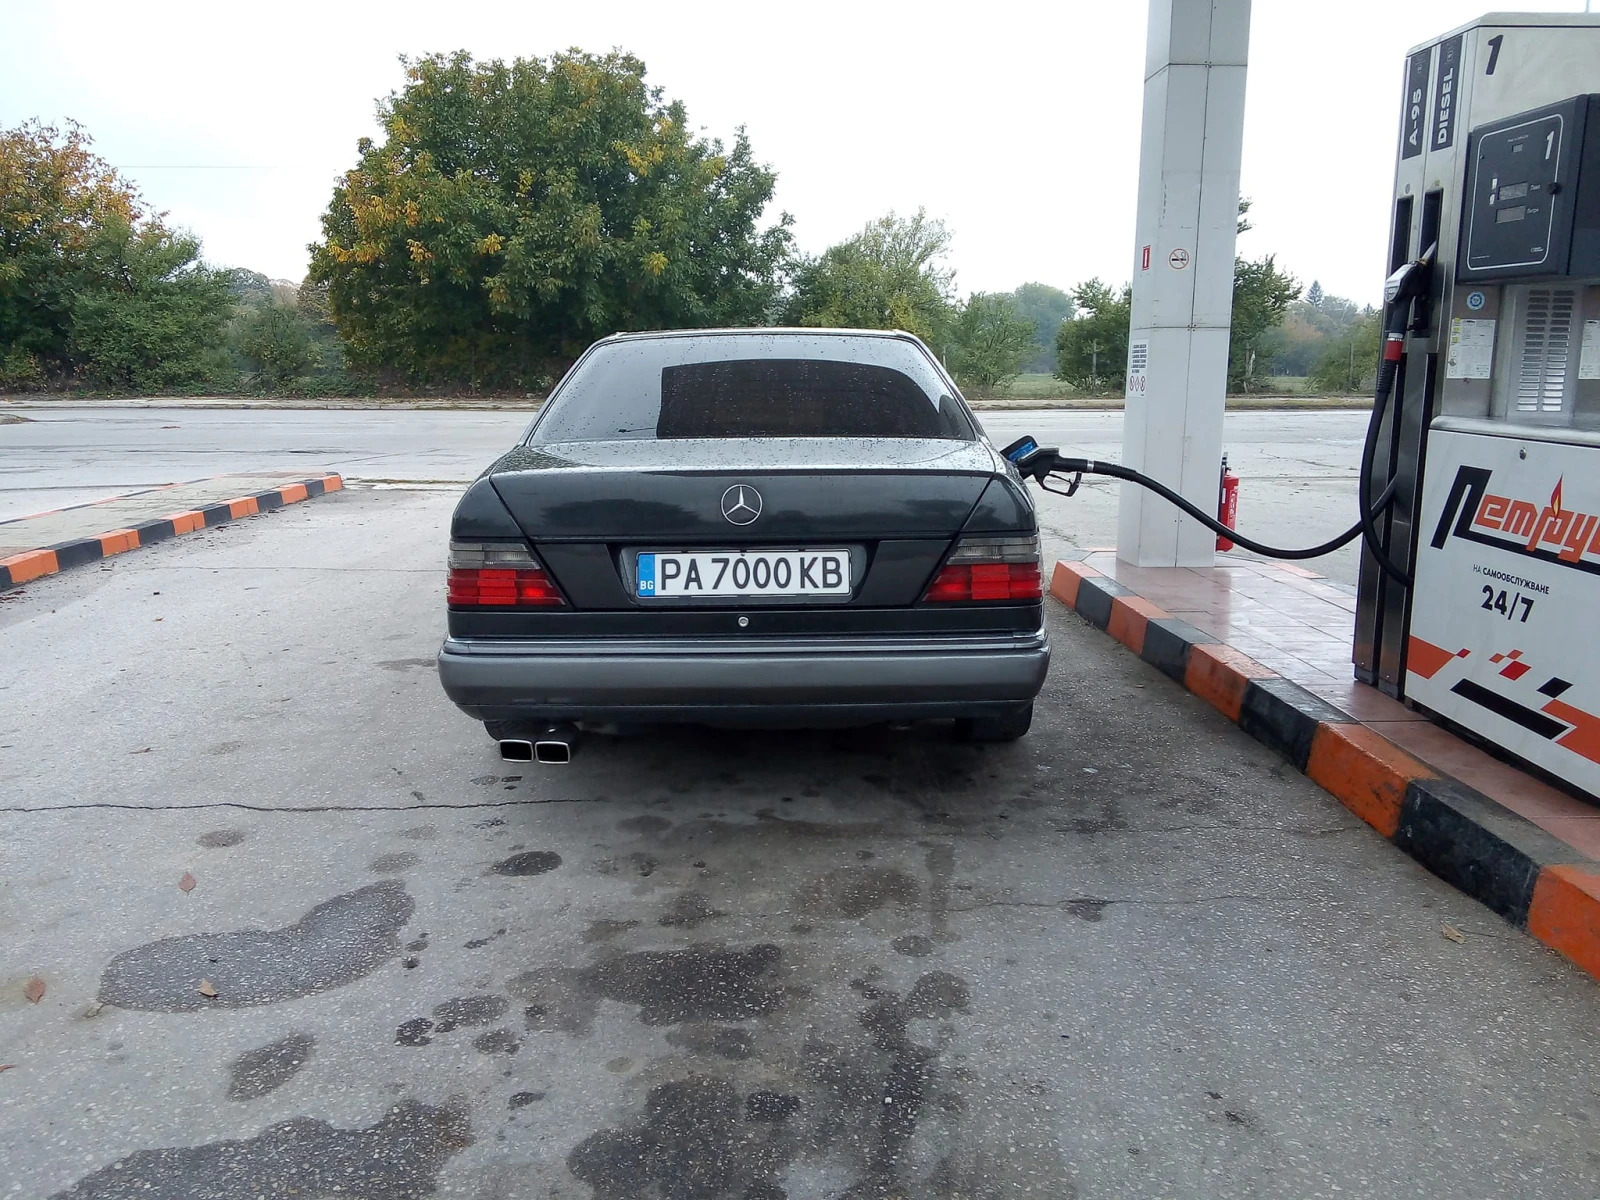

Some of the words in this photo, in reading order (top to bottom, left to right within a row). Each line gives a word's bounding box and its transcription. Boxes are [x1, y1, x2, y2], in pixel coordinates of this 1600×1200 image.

[1485, 34, 1503, 75] 1
[1409, 88, 1422, 146] A-95
[1437, 67, 1454, 145] DIESEL
[1545, 130, 1554, 160] 1
[640, 580, 654, 590] BG
[1482, 567, 1550, 595] САМООБСЛУЖВАНЕ
[1481, 584, 1535, 623] 24/7
